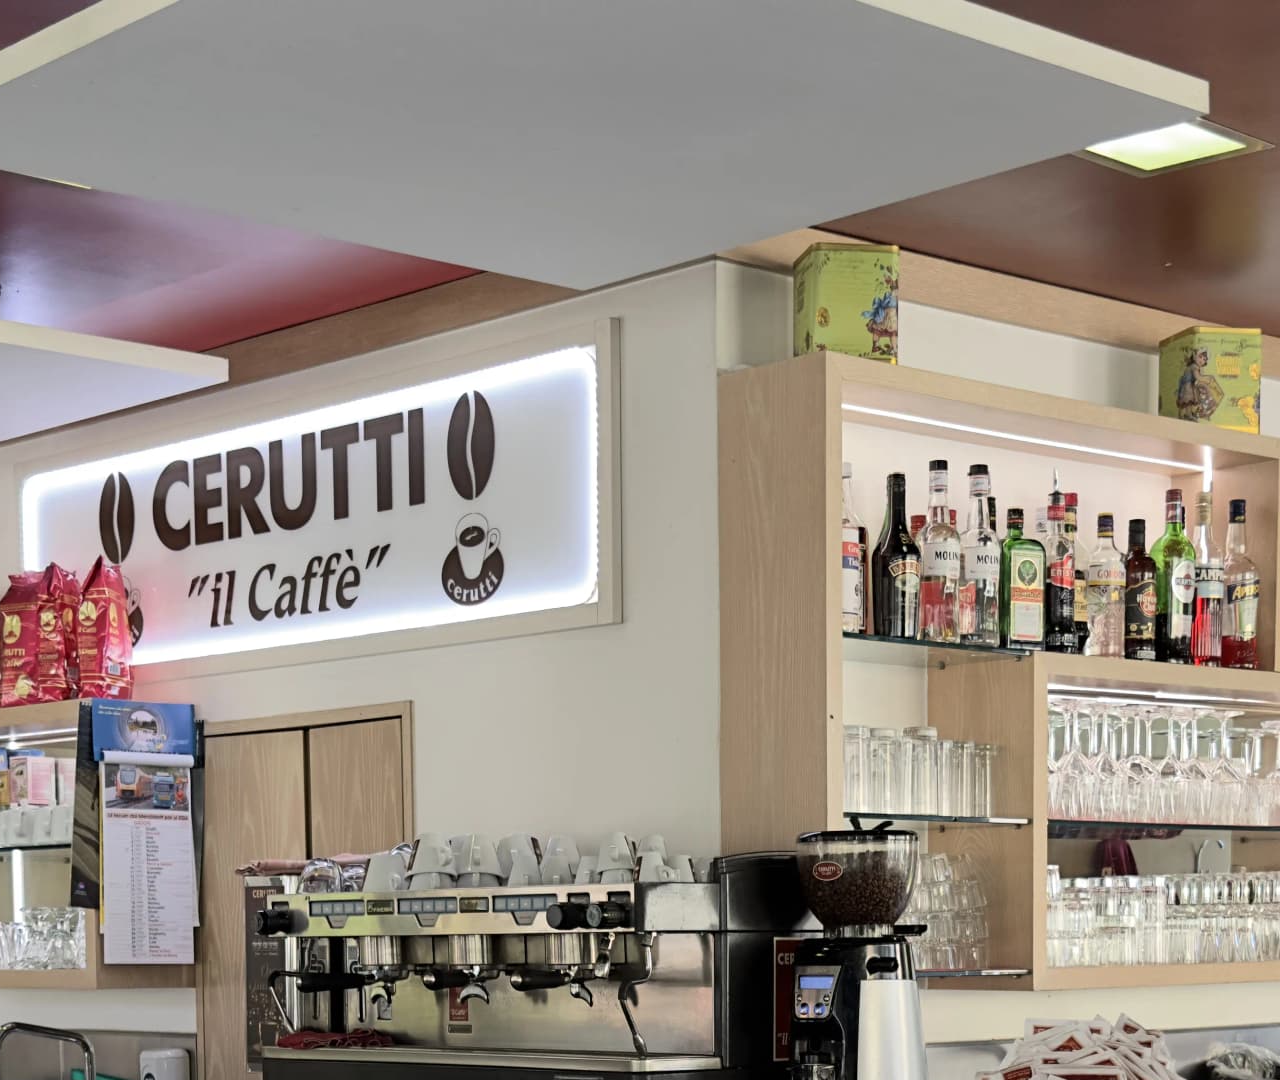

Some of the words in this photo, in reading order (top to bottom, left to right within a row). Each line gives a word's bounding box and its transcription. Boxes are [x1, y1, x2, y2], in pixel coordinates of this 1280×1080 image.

[152, 408, 426, 551] CERUTTI
[447, 571, 499, 602] cerutti
[3, 648, 26, 656] RUTTI
